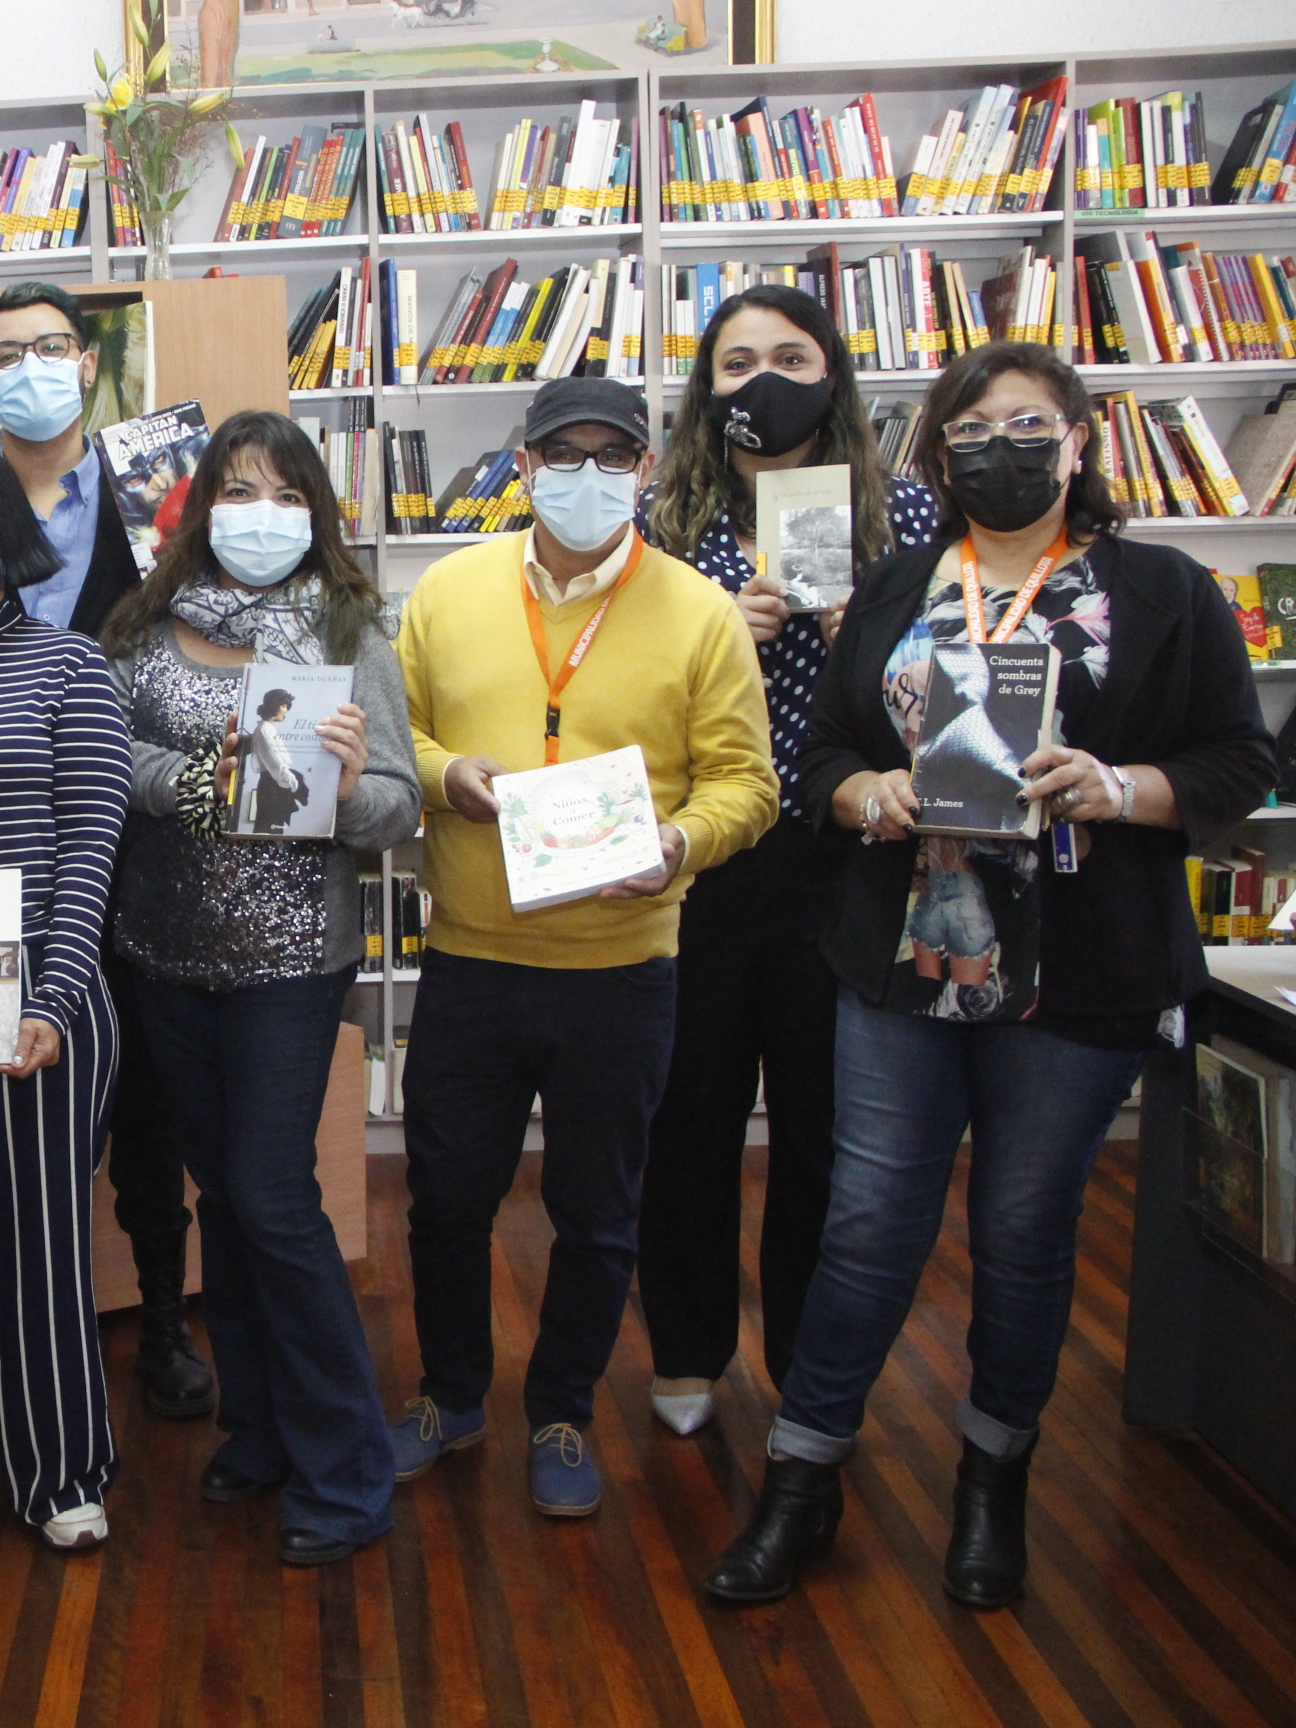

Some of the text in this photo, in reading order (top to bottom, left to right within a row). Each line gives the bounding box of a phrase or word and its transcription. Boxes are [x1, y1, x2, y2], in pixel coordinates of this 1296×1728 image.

[922, 281, 932, 306] ARTE
[1025, 556, 1054, 588] QUILLOTA
[989, 655, 1044, 666] Cincuenta
[291, 674, 314, 682] MARÍA
[997, 670, 1042, 680] sombras
[998, 684, 1041, 697] de Grey
[293, 718, 306, 730] El
[274, 732, 300, 741] entre
[933, 797, 964, 808] James
[553, 810, 596, 826] Comer
